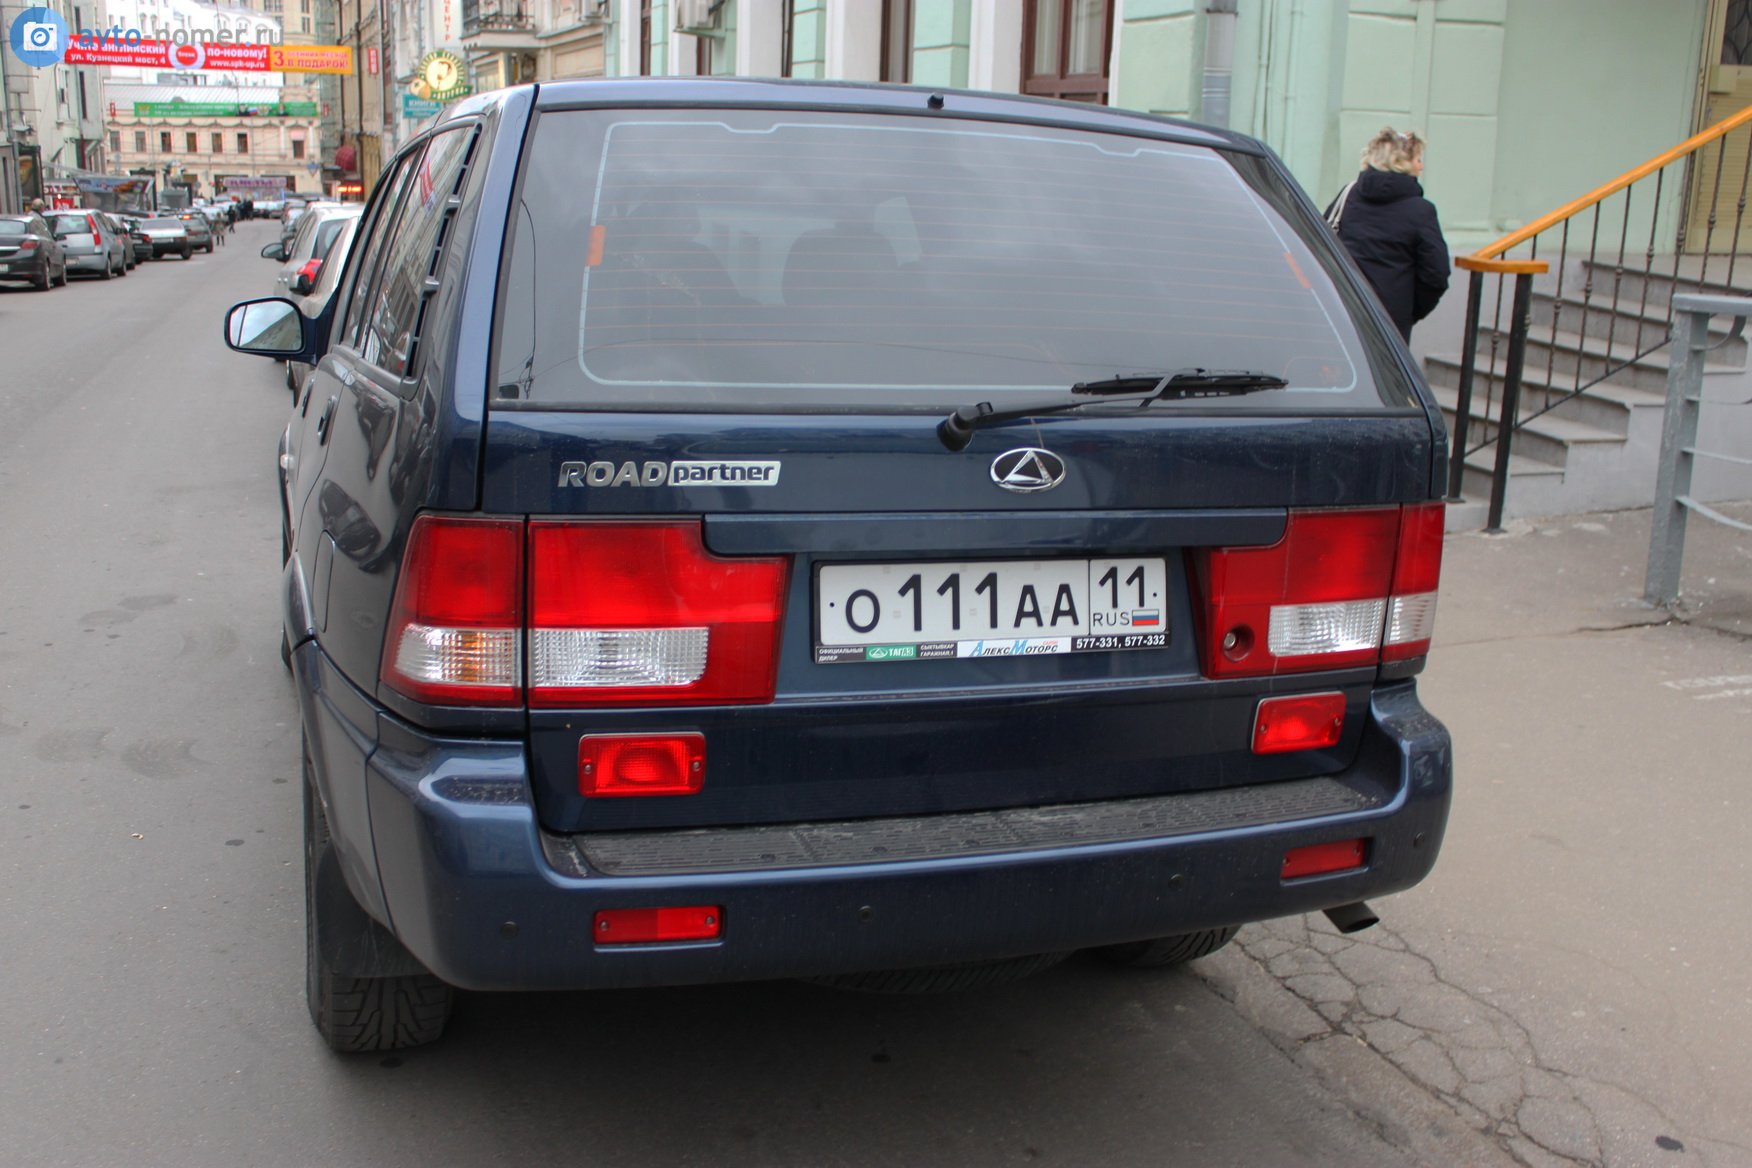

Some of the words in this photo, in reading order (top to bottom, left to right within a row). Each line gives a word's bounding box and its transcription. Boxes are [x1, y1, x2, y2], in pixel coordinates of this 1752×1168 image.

[70, 53, 84, 61] ул.
[87, 54, 133, 64] Кузнецкий
[135, 57, 158, 65] мост,
[207, 47, 267, 60] по-новому!
[274, 50, 284, 68] 3
[558, 461, 668, 488] ROAD
[673, 463, 775, 484] partner
[1099, 565, 1146, 609] 11
[1092, 611, 1131, 627] RUS
[1125, 635, 1165, 647] 577-332
